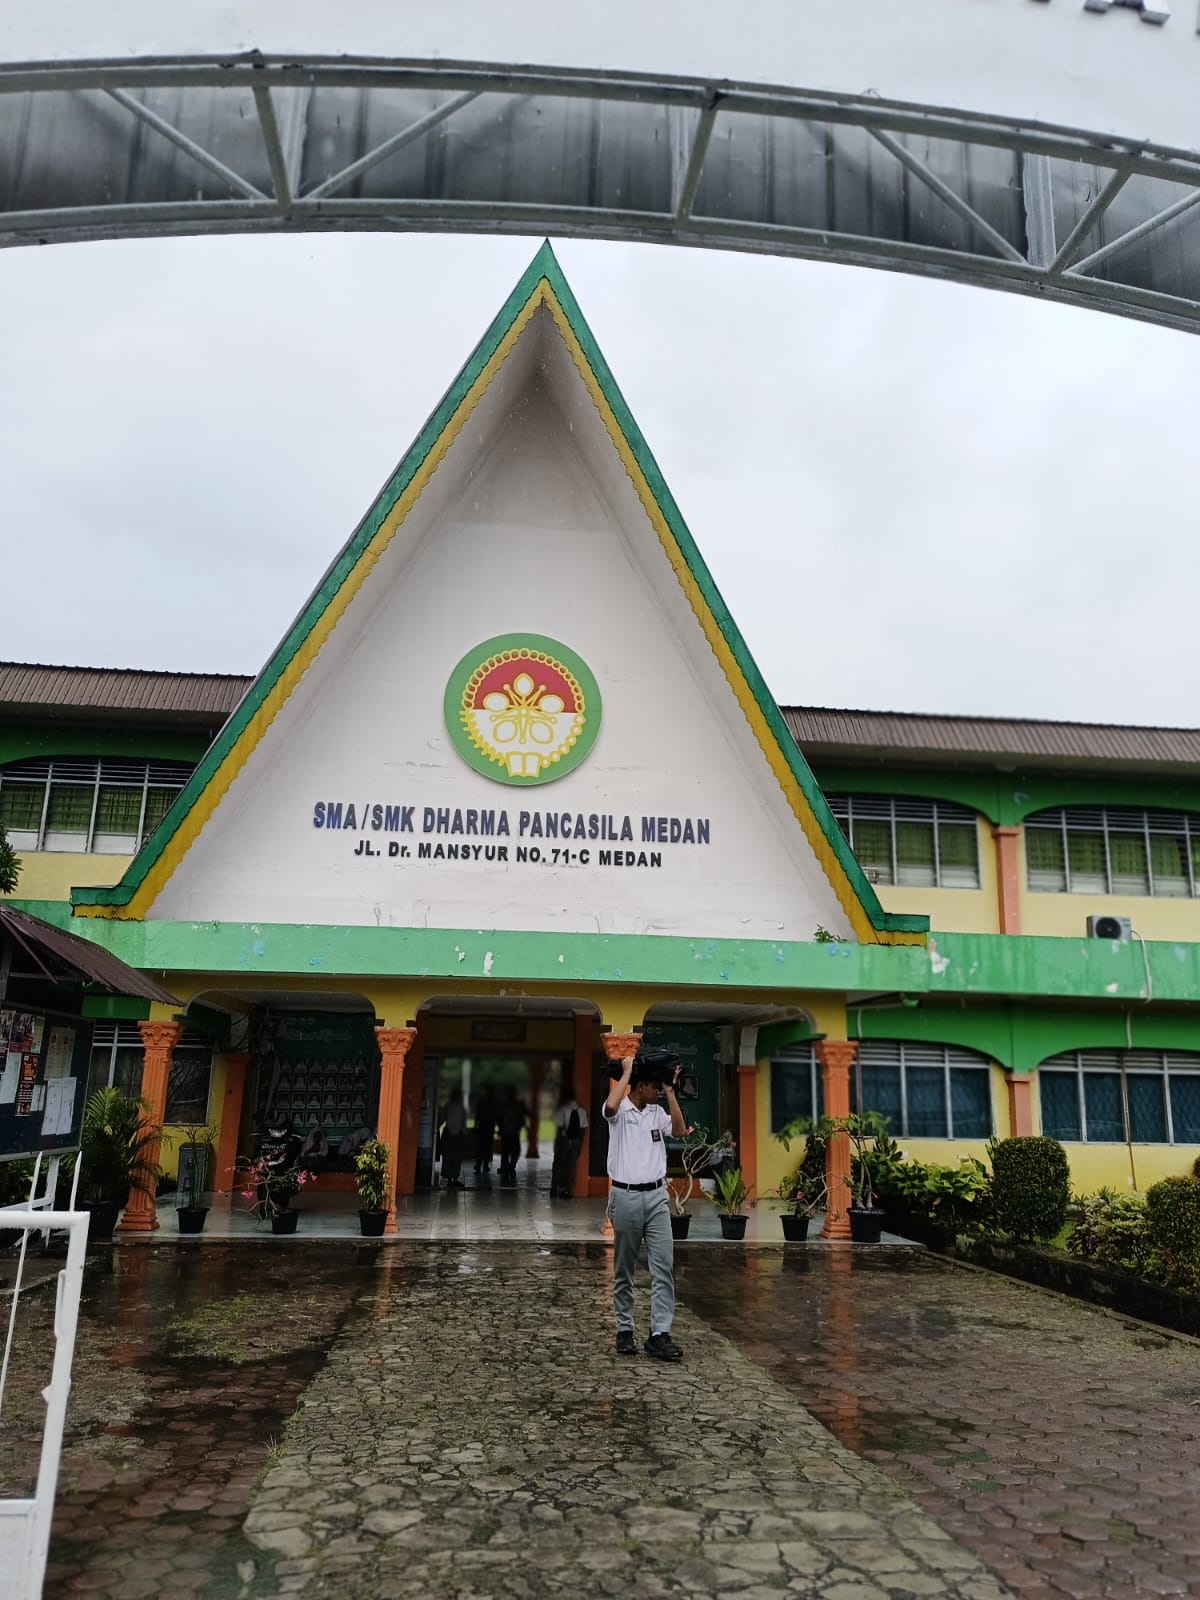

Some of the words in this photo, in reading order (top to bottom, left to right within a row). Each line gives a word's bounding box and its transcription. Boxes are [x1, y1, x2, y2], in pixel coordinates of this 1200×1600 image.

[423, 807, 510, 836] DHARMA
[518, 811, 634, 842] PANCASILA
[641, 816, 710, 844] MEDAN
[354, 840, 381, 857] JL.
[388, 841, 411, 858] Dr.
[418, 843, 508, 862] MANSYUR
[516, 846, 547, 864] NO.
[552, 848, 590, 865] 71-C
[599, 850, 662, 867] MEDAN
